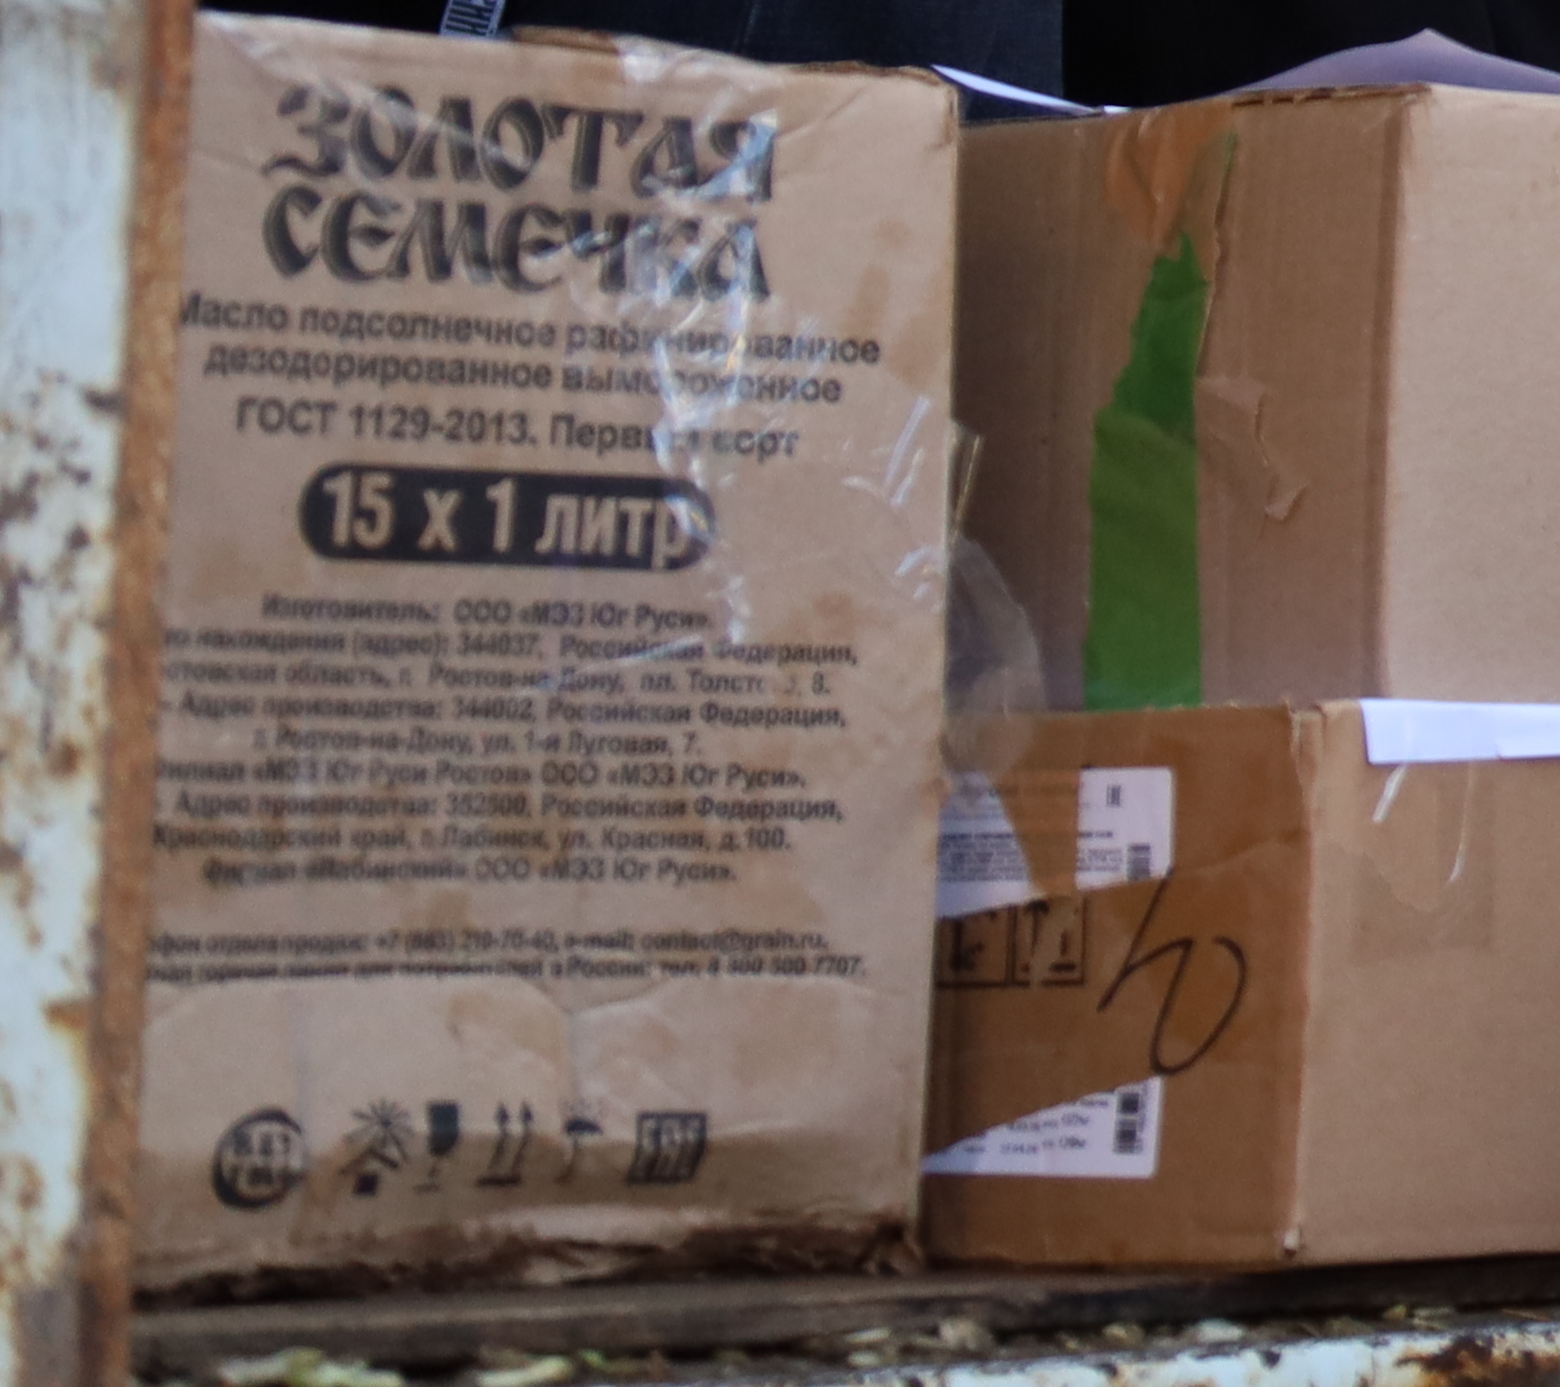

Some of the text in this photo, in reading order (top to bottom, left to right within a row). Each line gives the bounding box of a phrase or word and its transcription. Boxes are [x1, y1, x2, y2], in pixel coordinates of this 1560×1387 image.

[261, 84, 776, 202] ЗОЛОТАЯ
[261, 184, 771, 302] СЕМЕЧКА
[300, 304, 556, 349] подсолнечное
[203, 342, 551, 390] дезодорированное
[236, 394, 337, 435] ГОСТ
[350, 401, 537, 448] 1129-2013.
[323, 470, 391, 545] 15
[486, 476, 517, 552] 1
[536, 498, 690, 570] литр
[454, 596, 513, 626] ООО
[541, 760, 600, 787] ООО
